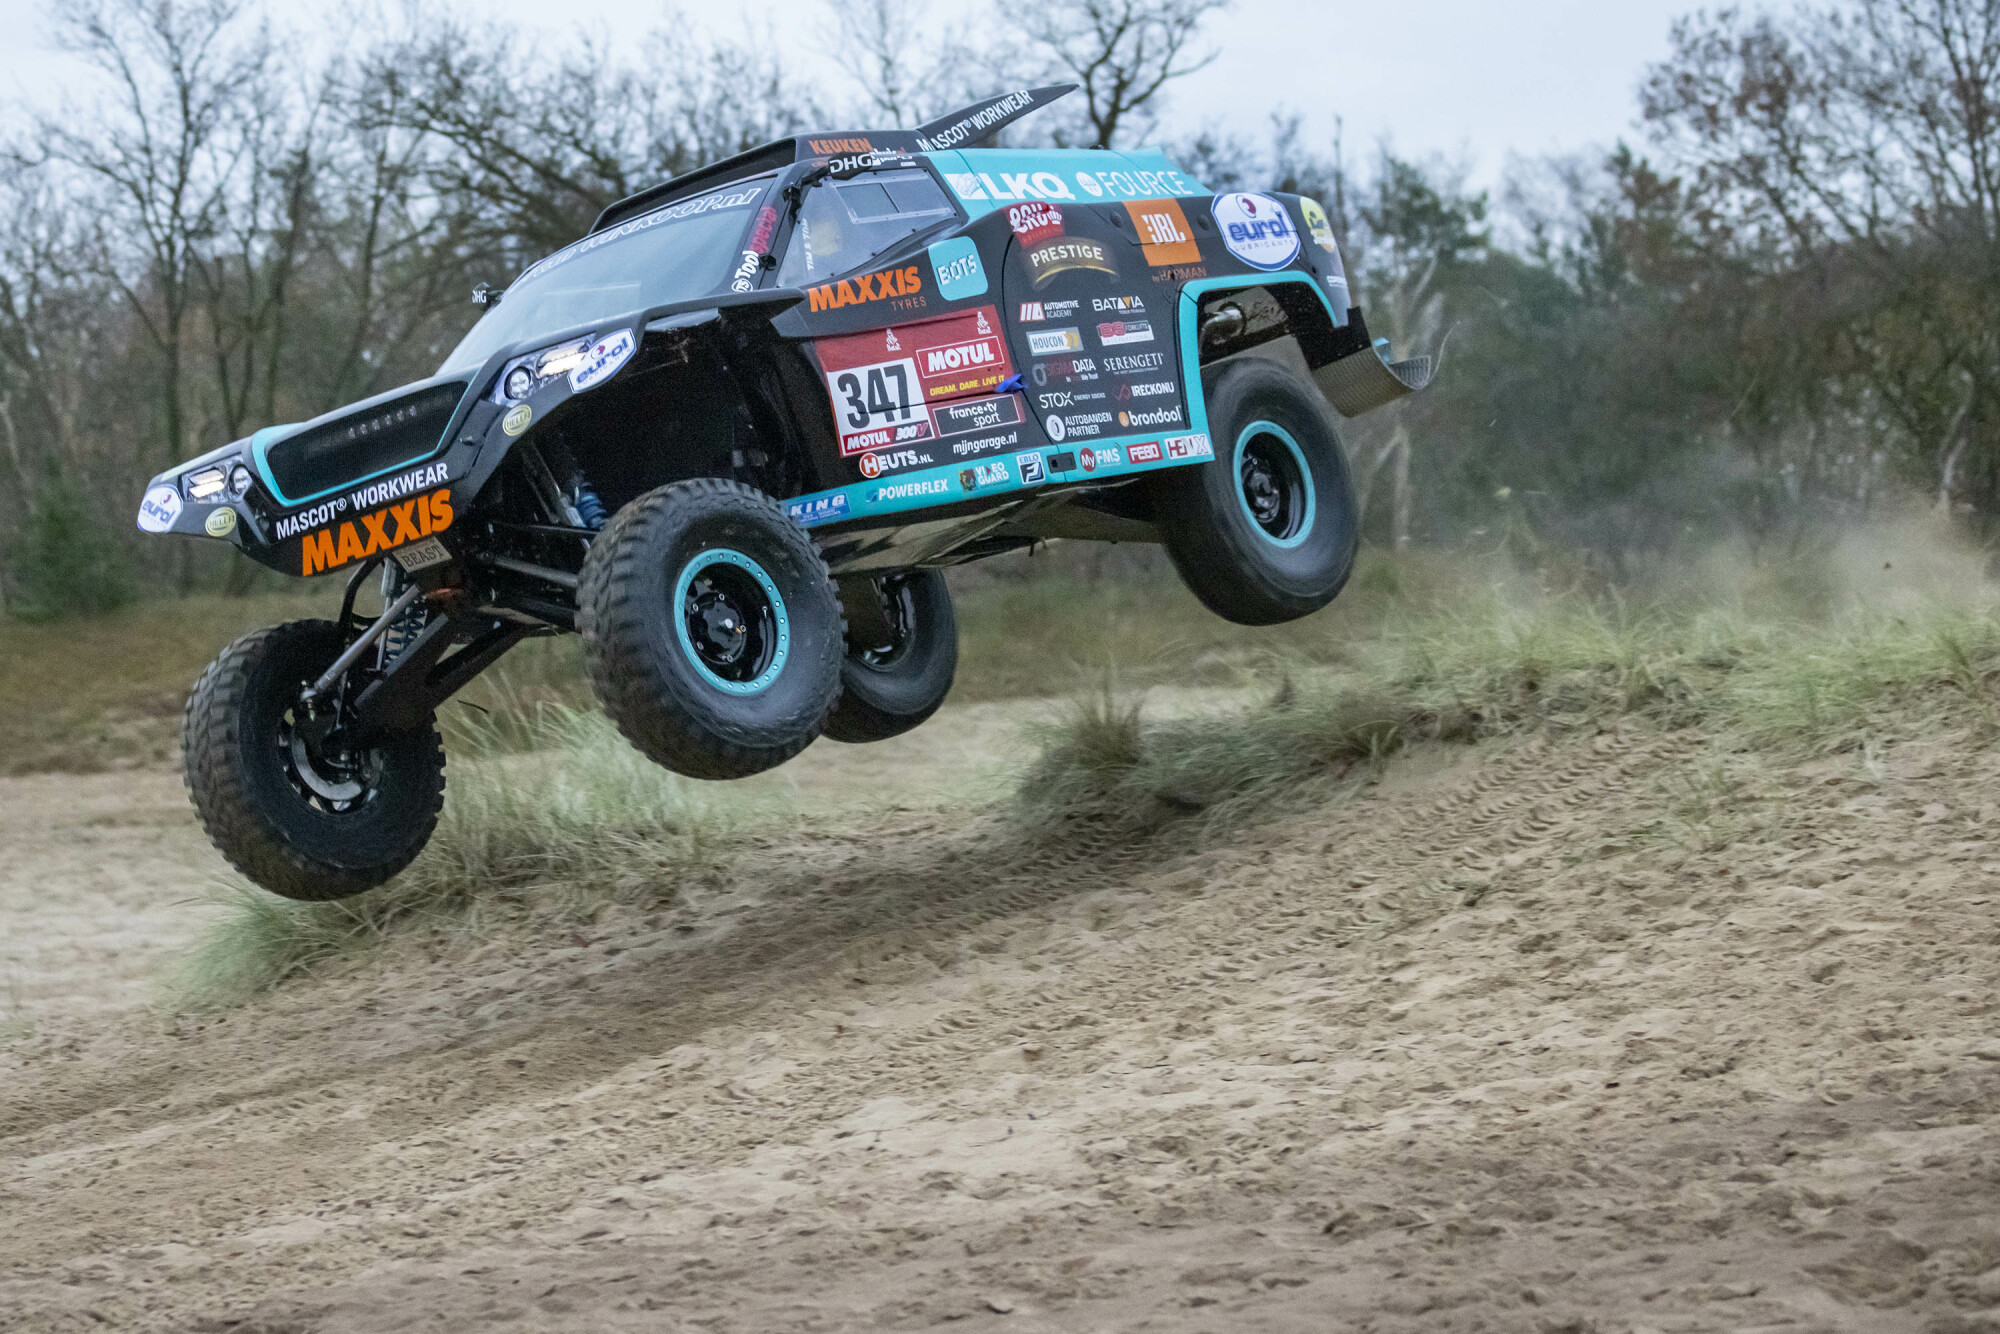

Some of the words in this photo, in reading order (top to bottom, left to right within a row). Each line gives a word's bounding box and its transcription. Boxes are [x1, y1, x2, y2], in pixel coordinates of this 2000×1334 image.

[969, 90, 1034, 130] WORKWEAR
[808, 138, 874, 154] KEUKEN
[828, 154, 873, 174] DHG
[979, 172, 1076, 200] LKQ
[1099, 171, 1194, 197] FOURCE
[1147, 213, 1186, 245] JBL
[1228, 211, 1290, 243] eurol
[1030, 245, 1104, 267] PRESTIGE
[1234, 240, 1295, 251] LUBRICANTS
[935, 254, 977, 285] BOTS
[808, 266, 922, 313] MAXXIS
[891, 296, 927, 312] TYRES
[1044, 300, 1080, 311] AUTOMOTIVE
[1046, 309, 1073, 319] ACADEMY
[1092, 295, 1145, 312] BATAVIA
[1032, 335, 1065, 350] HOUCON
[576, 336, 629, 384] eurol
[928, 342, 995, 372] MOTUL
[1072, 358, 1097, 373] DATA
[1103, 353, 1162, 371] SERENGETI
[837, 363, 912, 429] 347
[929, 384, 958, 397] DREAM.
[959, 379, 981, 391] DARE.
[982, 376, 998, 386] LIVE
[1039, 391, 1075, 409] STOX
[973, 412, 1001, 428] sport
[1065, 411, 1113, 426] AUTOBANDEN
[1128, 405, 1182, 426] brondool
[847, 430, 891, 451] MOTUL
[895, 422, 929, 441] 300V
[1067, 424, 1101, 437] PARTNER
[953, 431, 1018, 455] mijngarage.nl
[1129, 443, 1160, 462] FEBO
[863, 450, 934, 474] HEUTS.NL
[351, 462, 449, 511] WORKWEAR
[977, 471, 1010, 485] GUARD
[878, 479, 949, 501] POWERFLEX
[142, 500, 176, 524] eurol
[790, 494, 846, 516] KING
[302, 488, 454, 577] MAXXIS
[401, 545, 444, 567] BEAST
